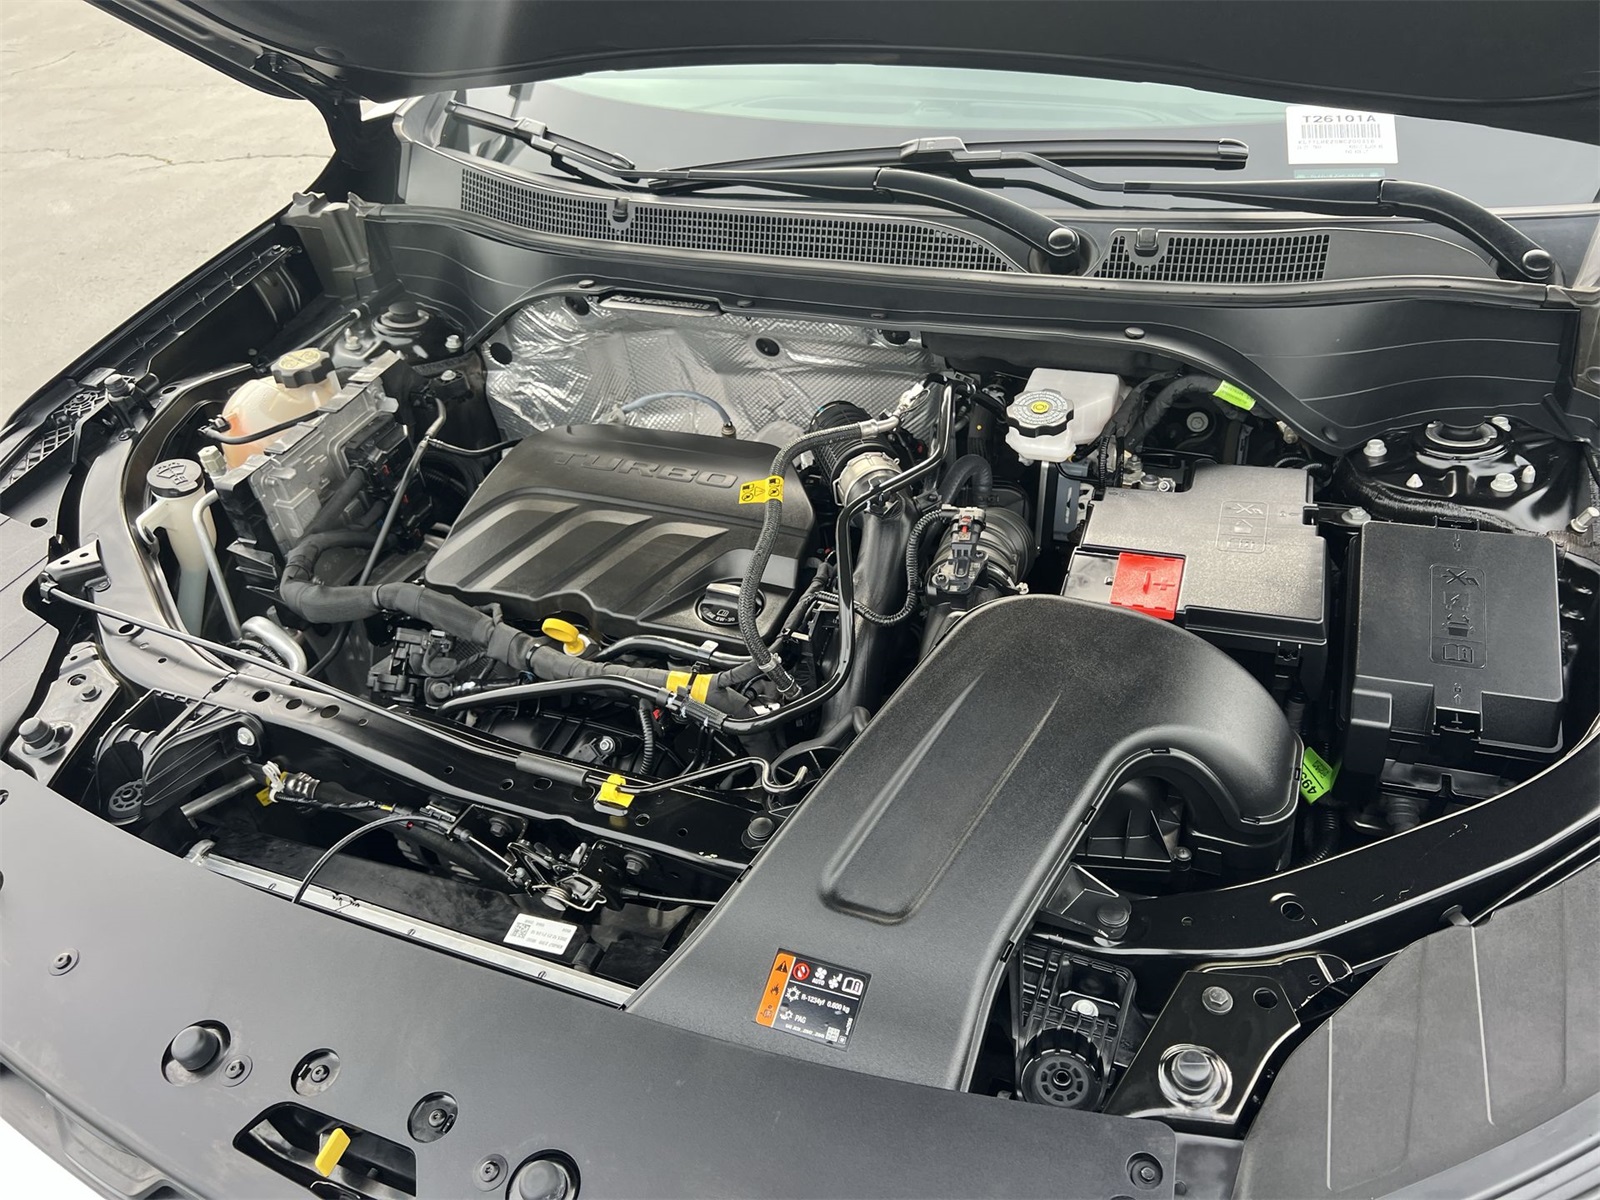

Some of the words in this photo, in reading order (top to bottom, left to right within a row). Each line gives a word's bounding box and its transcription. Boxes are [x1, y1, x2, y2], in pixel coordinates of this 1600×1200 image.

[1302, 114, 1376, 123] T26101A
[553, 452, 739, 488] TURBO
[812, 977, 825, 986] AUTO
[842, 1004, 851, 1014] kg
[794, 1014, 807, 1024] PAG
